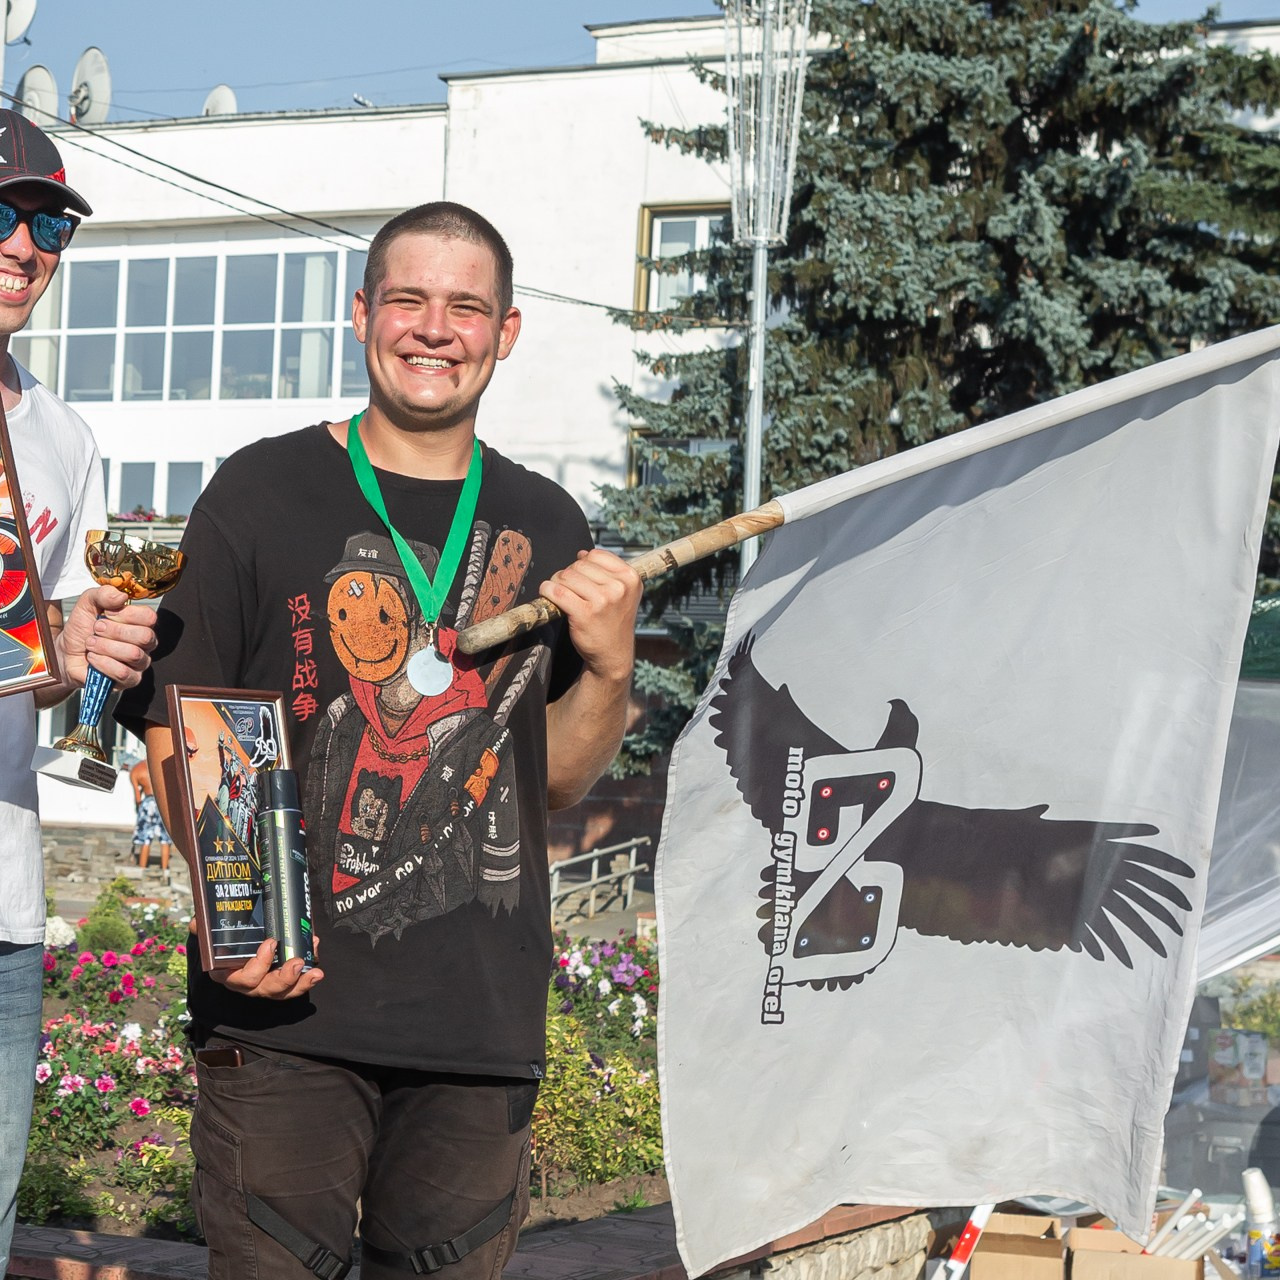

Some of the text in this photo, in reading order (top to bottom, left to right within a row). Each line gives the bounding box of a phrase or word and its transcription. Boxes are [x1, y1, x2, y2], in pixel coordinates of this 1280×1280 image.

[287, 592, 319, 722] 没有战争
[206, 862, 252, 881] ДИПЛОМ
[336, 861, 414, 913] no war no
[762, 746, 804, 1024] moto gymkhana orel
[215, 884, 224, 898] ЗА
[224, 883, 229, 898] 2
[229, 883, 249, 897] МЕСТО
[216, 900, 253, 912] НАГРАЖДАЕТСЯ
